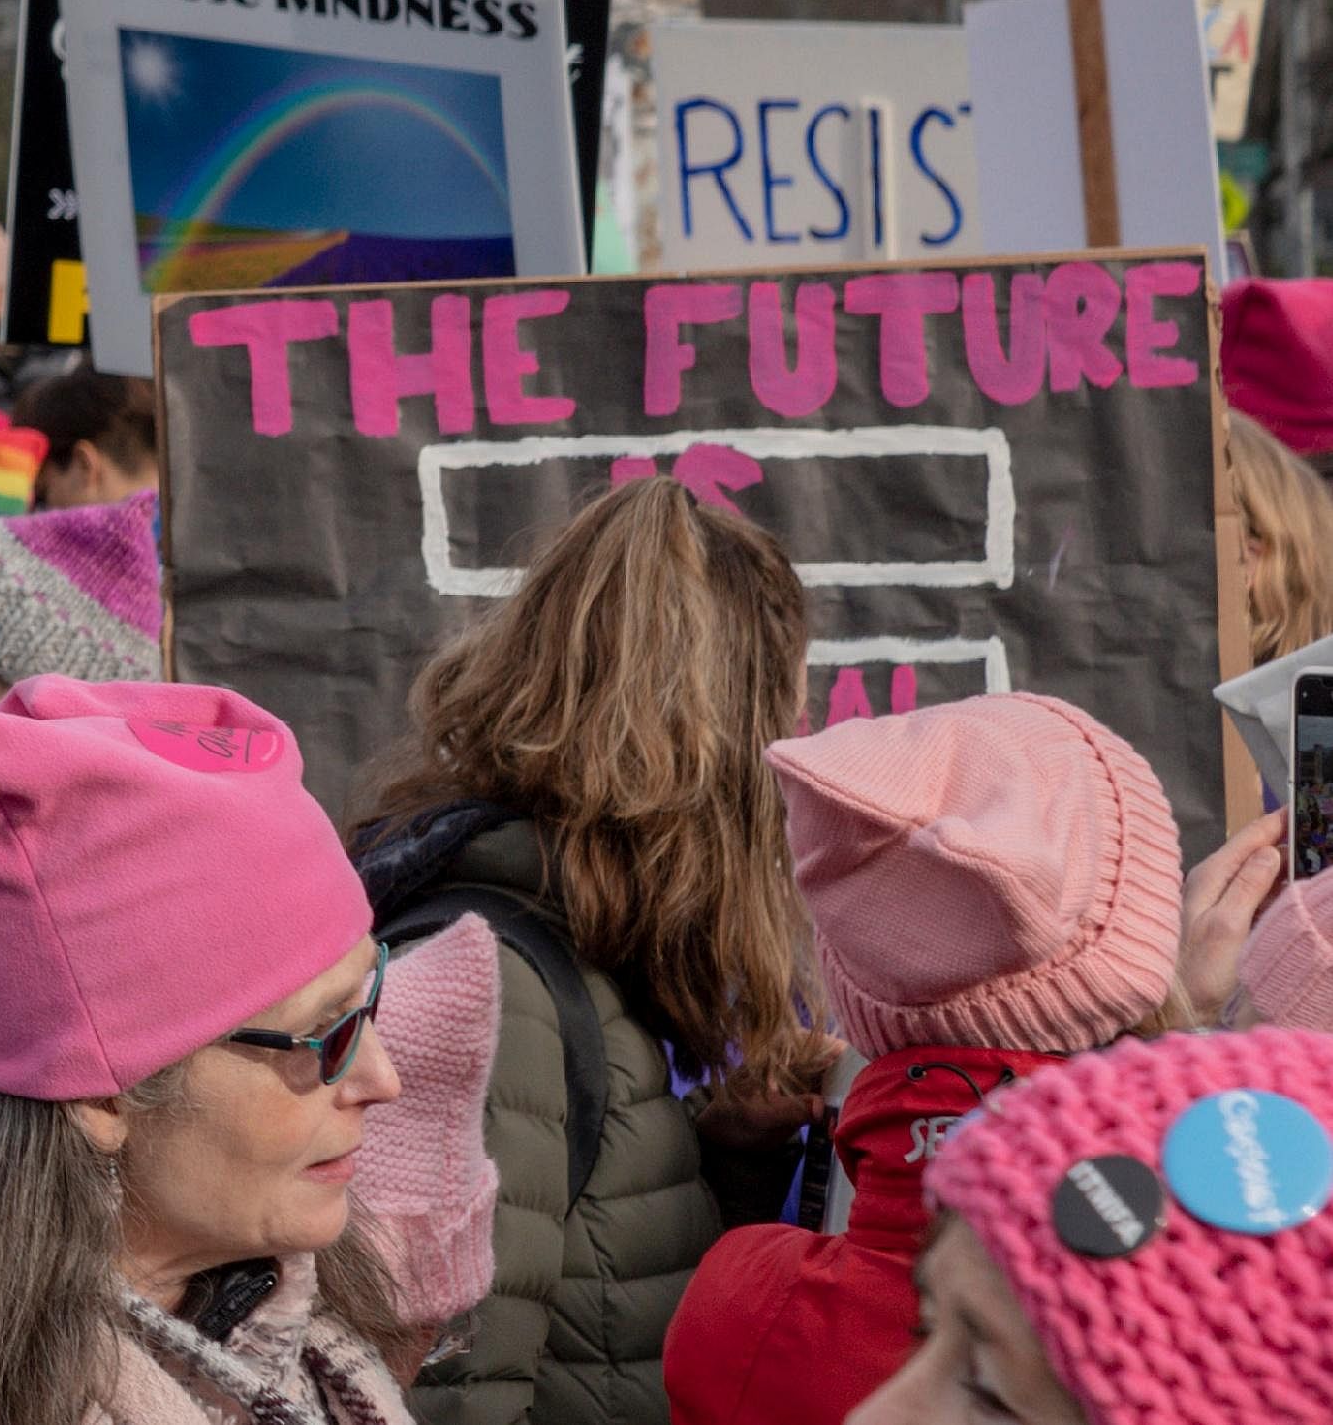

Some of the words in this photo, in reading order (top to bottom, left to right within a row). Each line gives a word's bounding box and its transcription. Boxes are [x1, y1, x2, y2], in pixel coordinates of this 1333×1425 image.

[675, 96, 972, 250] RESIS
[189, 288, 578, 439] THE
[643, 259, 1202, 418] FUTURE
